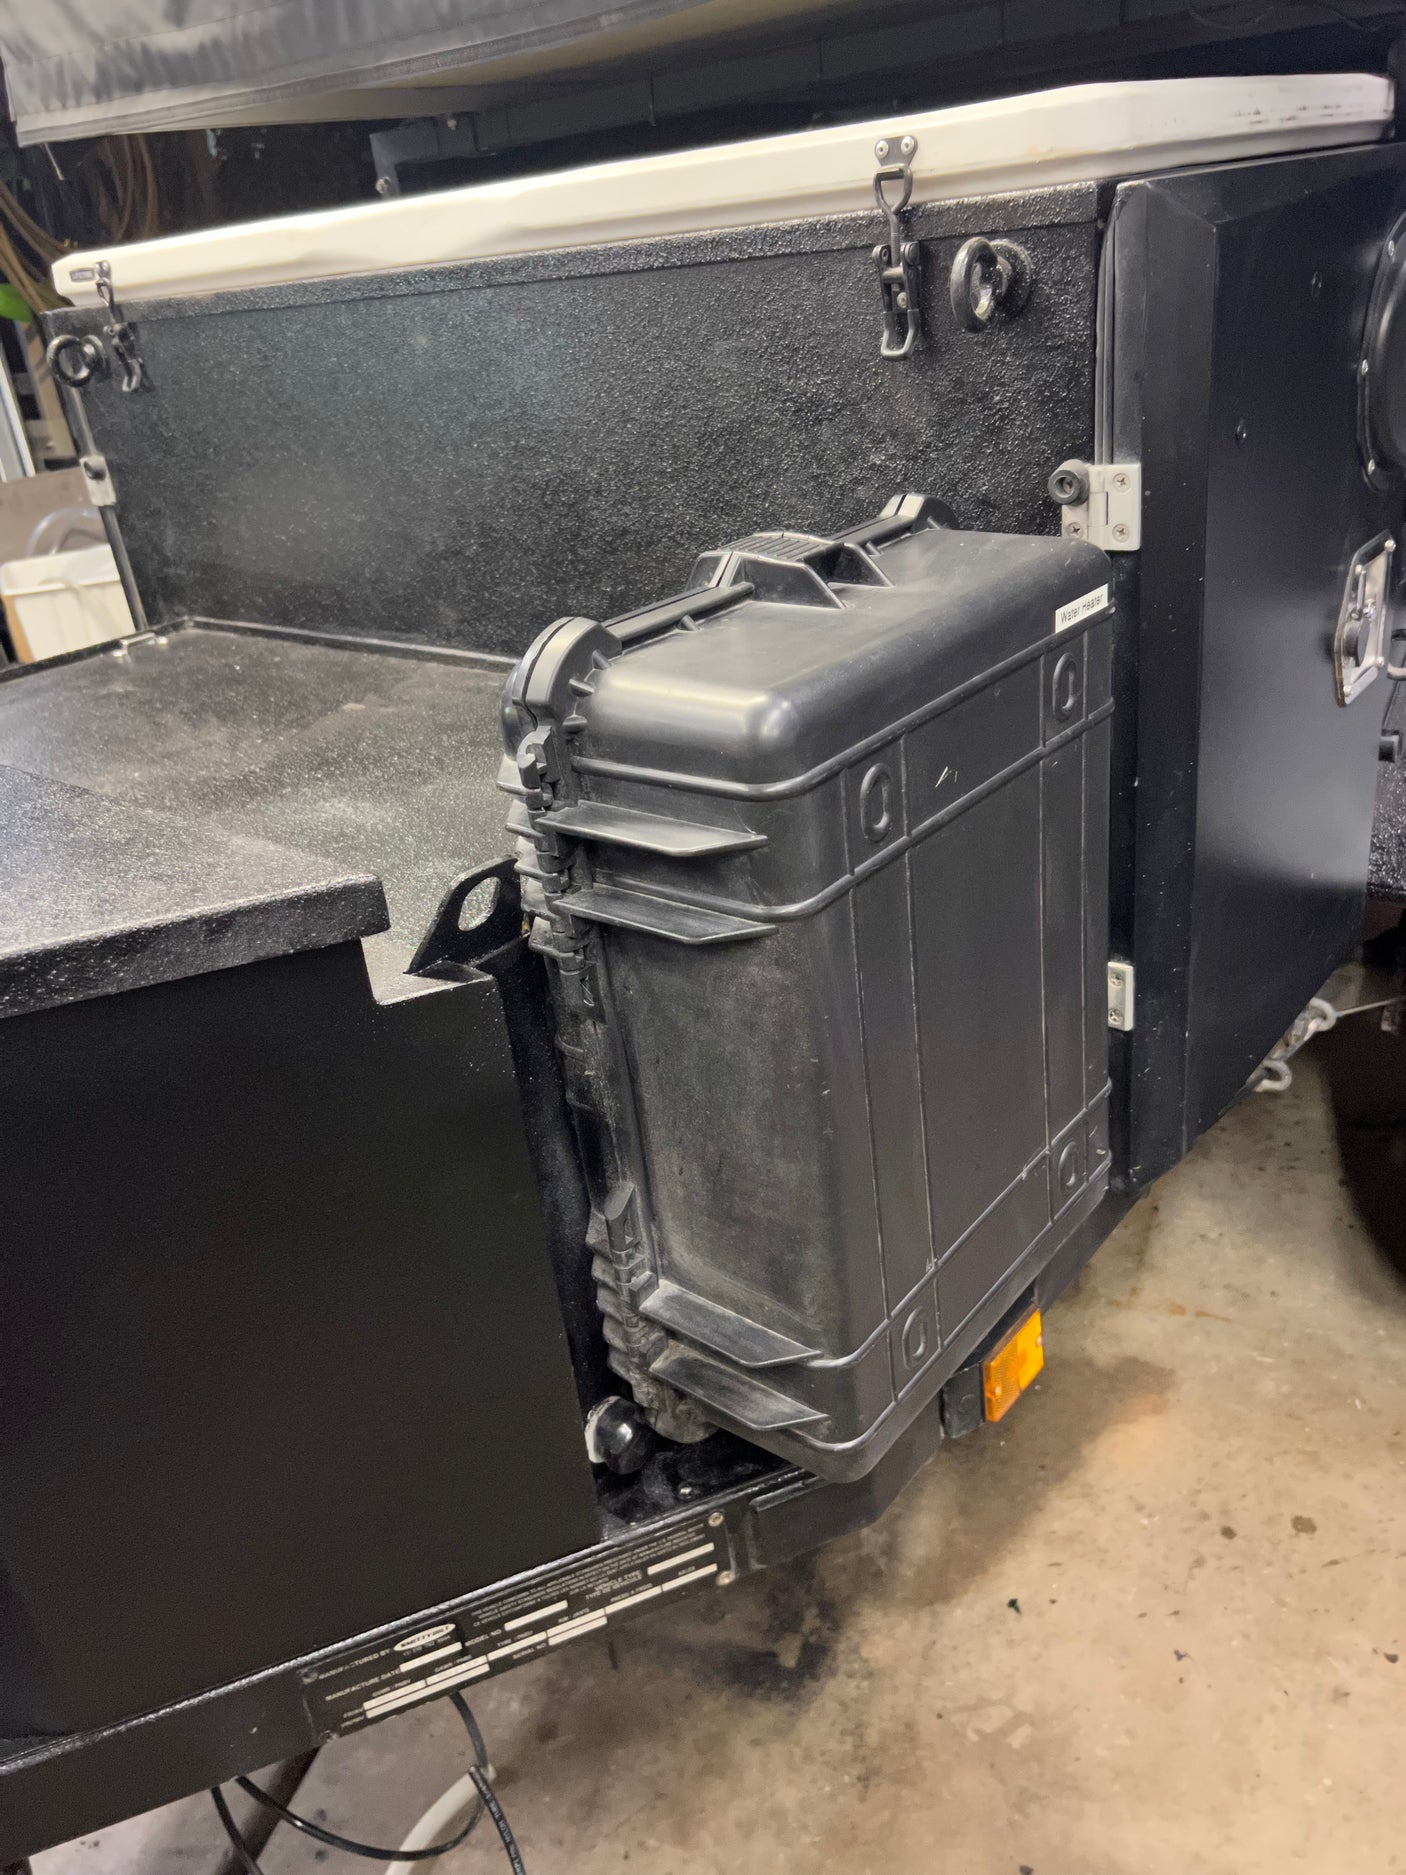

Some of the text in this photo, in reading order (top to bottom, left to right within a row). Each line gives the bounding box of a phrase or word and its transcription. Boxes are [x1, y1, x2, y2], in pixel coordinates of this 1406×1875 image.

[1061, 594, 1103, 624] Water Heater
[318, 1653, 379, 1680] MANUFACTURED
[325, 1668, 401, 1701] MANUFACTURE DATE
